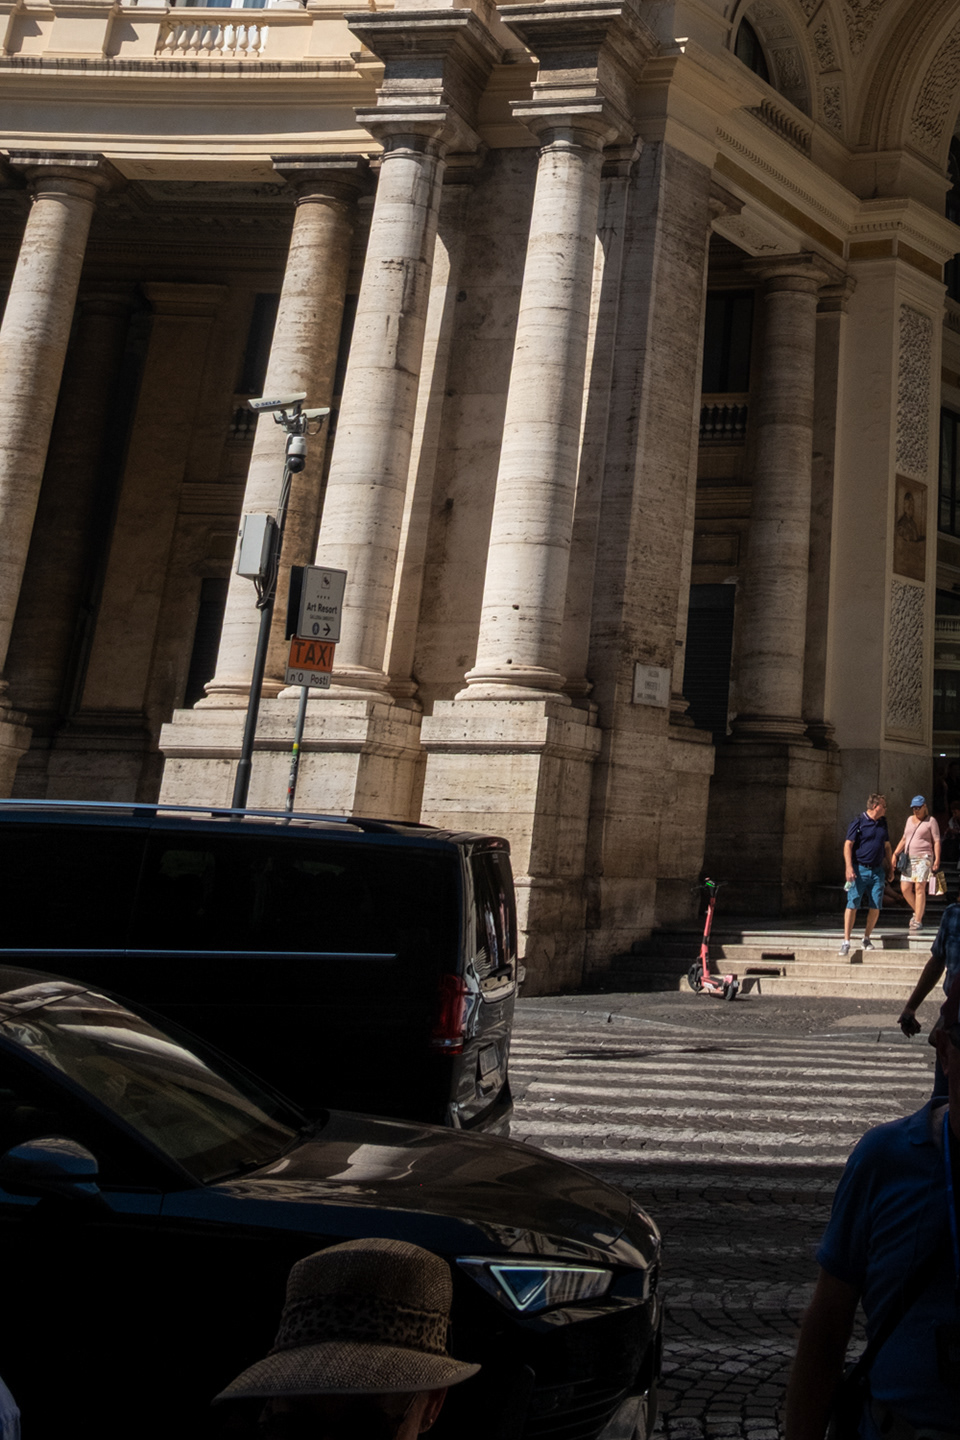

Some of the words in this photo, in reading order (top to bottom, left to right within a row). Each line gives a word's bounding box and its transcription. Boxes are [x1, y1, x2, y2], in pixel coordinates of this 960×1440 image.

[306, 602, 317, 612] Art
[318, 603, 338, 614] Resort
[294, 641, 333, 667] TAXI
[310, 673, 329, 685] Posti
